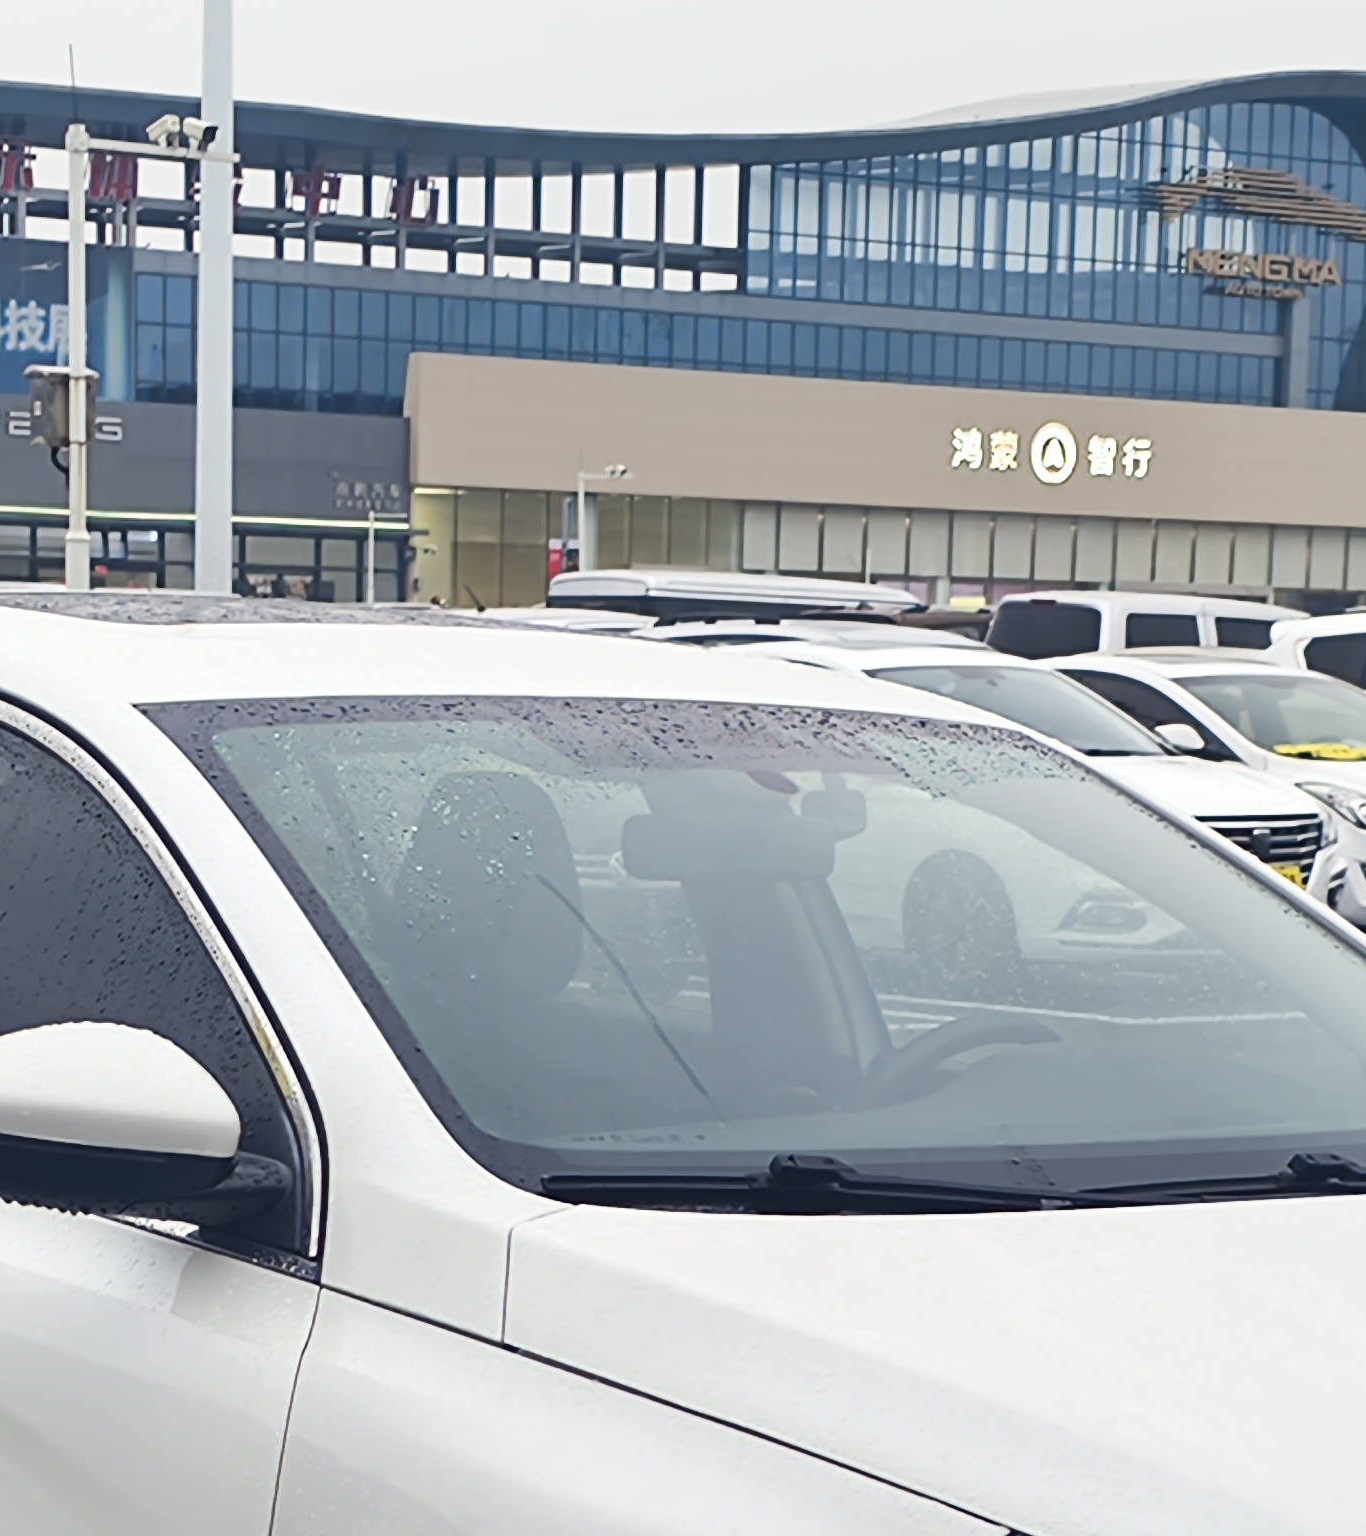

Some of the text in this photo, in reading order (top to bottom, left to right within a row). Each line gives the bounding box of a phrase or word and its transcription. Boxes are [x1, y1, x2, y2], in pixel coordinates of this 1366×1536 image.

[1188, 248, 1343, 287] MENGMA
[950, 427, 1154, 479] 鸿蒙 智行
